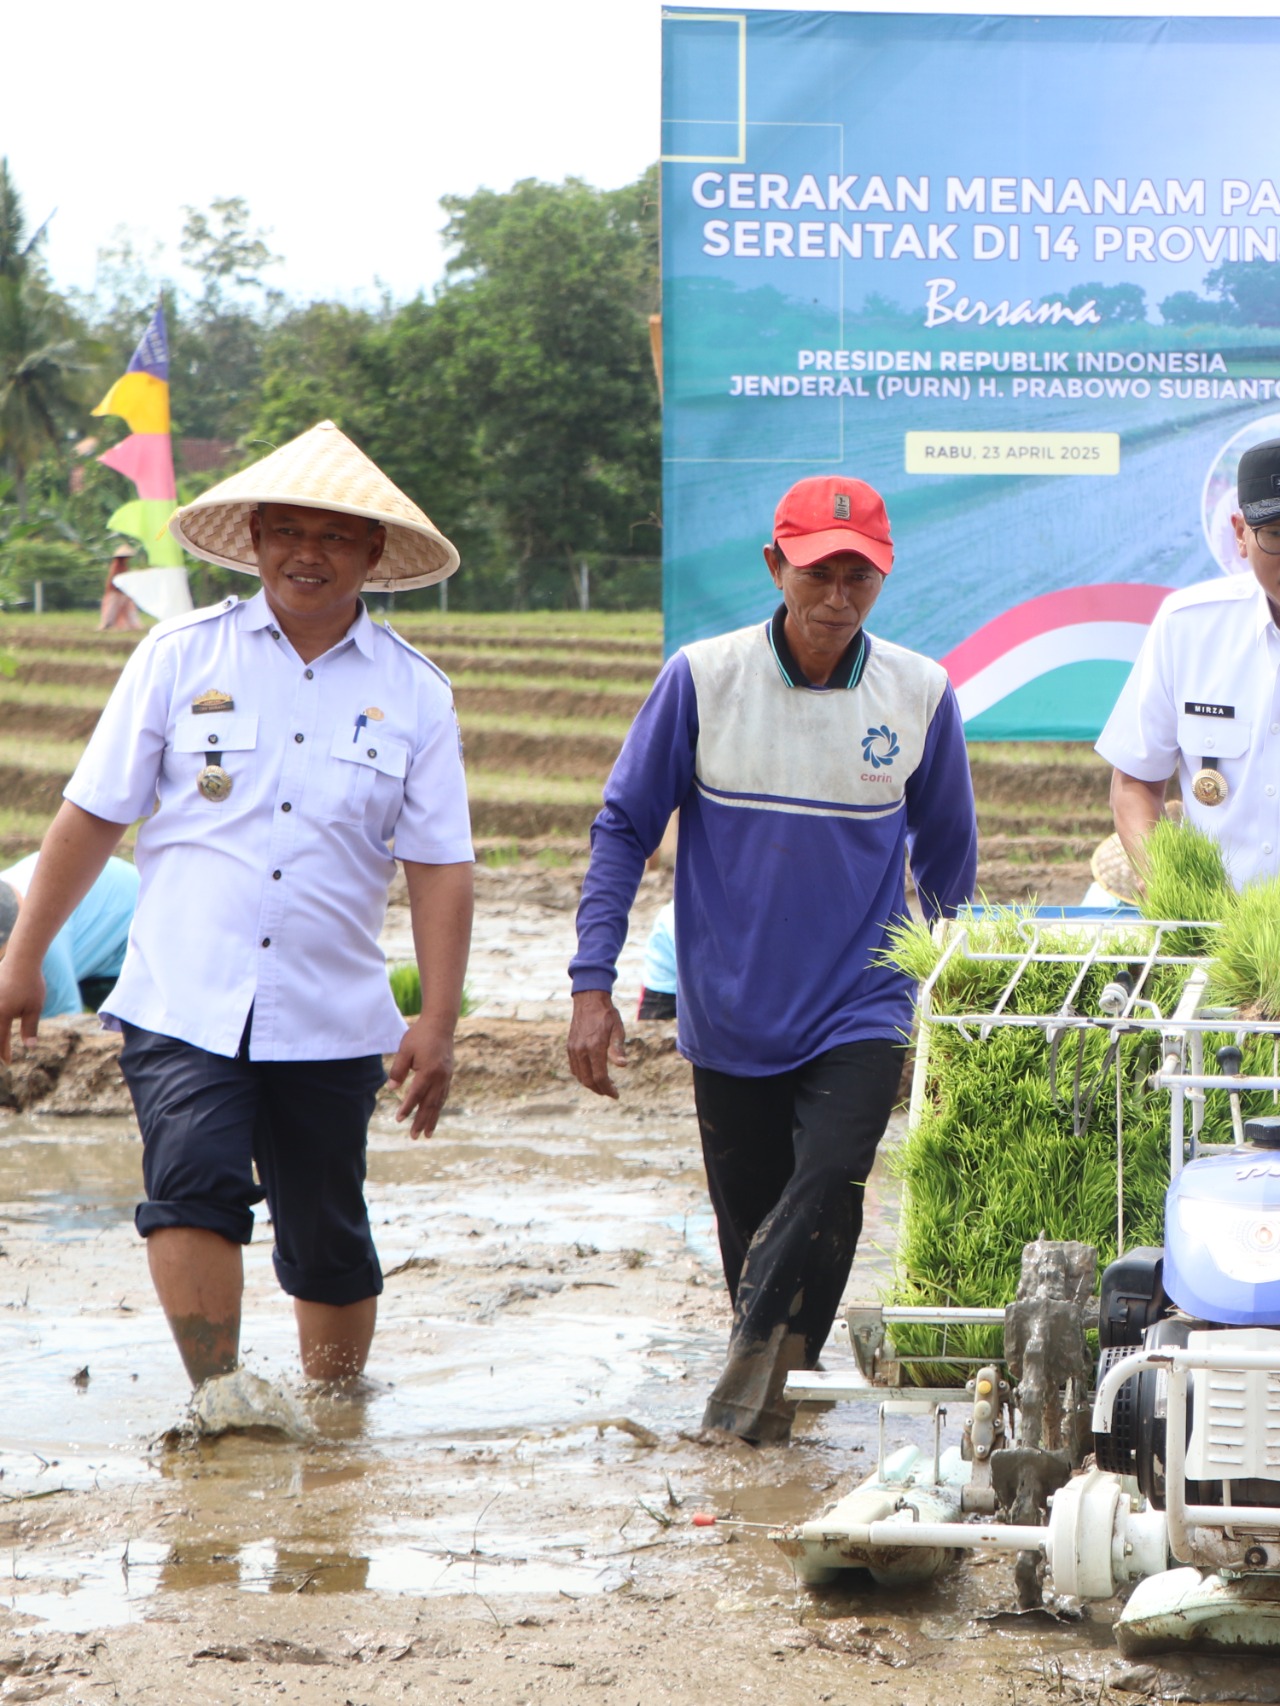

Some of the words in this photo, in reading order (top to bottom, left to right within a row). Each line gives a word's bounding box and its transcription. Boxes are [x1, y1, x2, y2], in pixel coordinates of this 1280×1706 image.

[691, 171, 930, 212] GERAKAN
[946, 176, 1205, 216] MENANAM
[702, 219, 959, 260] SERENTAK
[972, 223, 1020, 261] DI
[1033, 224, 1080, 262] 14
[923, 277, 1101, 329] Bersama
[797, 350, 932, 372] PRESIDEN
[939, 351, 1069, 373] REPUBLIK
[1077, 352, 1228, 374] INDONESIA
[729, 375, 870, 397] JENDERAL
[876, 375, 971, 401] (PURN)
[978, 377, 1004, 398] H.
[1012, 377, 1152, 399] PRABOWO
[924, 445, 977, 460] RABU,
[982, 445, 1000, 460] 23
[1006, 446, 1055, 460] APRIL
[1060, 446, 1101, 461] 2025
[1194, 705, 1224, 715] MIRZA
[860, 772, 892, 783] corin
